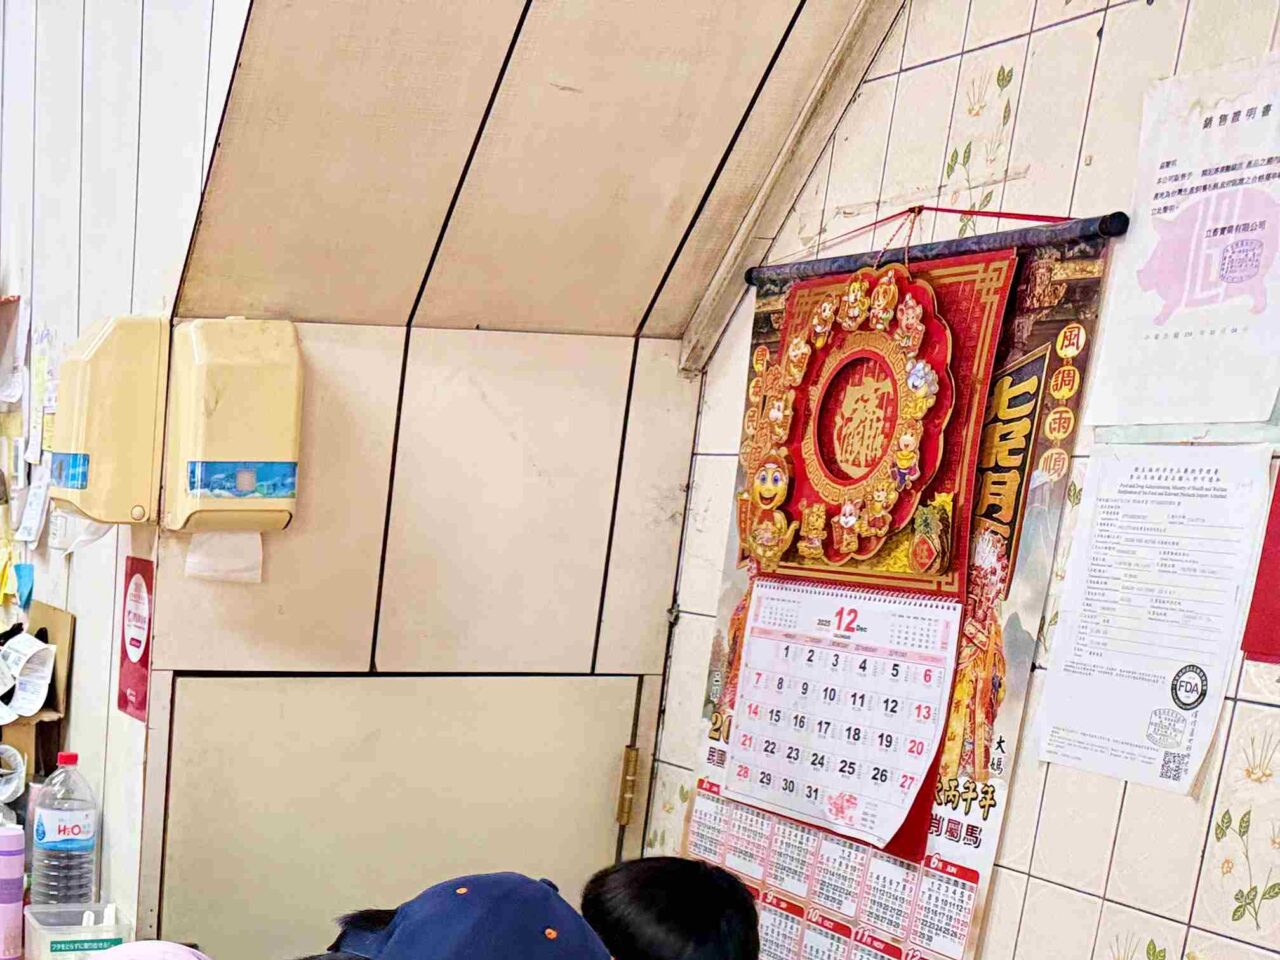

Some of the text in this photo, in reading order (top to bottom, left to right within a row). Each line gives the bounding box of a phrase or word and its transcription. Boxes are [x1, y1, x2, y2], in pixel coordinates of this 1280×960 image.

[1042, 326, 1081, 480] 風調雨順
[835, 607, 858, 633] 12
[784, 645, 790, 658] 1
[806, 649, 815, 663] 2
[831, 653, 840, 668] 3
[858, 658, 868, 673] 4
[891, 663, 900, 678] 5
[923, 668, 933, 684] 6
[755, 671, 932, 720] 7 8 9 10 11 12 13
[1178, 680, 1200, 695] FDA
[747, 704, 925, 756] 14 15 16 17 18 19 20
[736, 765, 819, 801] 28 29 30 31
[740, 734, 916, 790] 21 22 23 24 25 26 27
